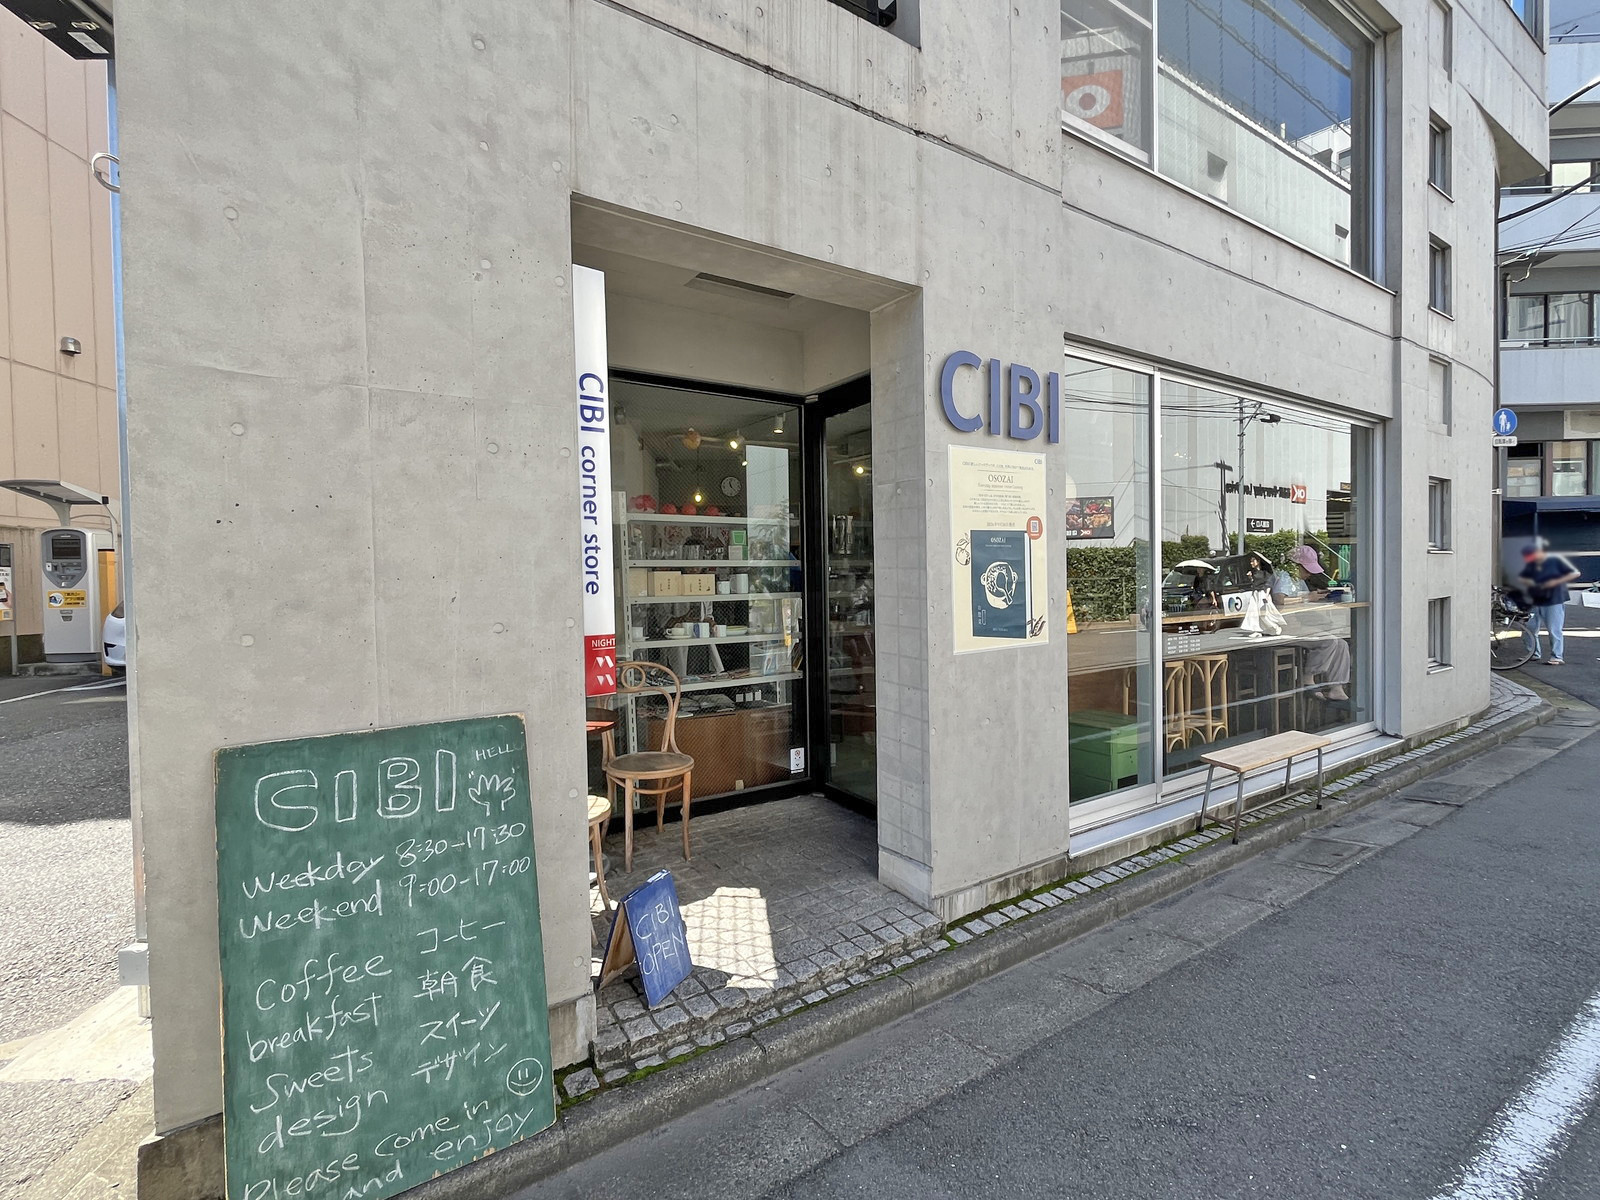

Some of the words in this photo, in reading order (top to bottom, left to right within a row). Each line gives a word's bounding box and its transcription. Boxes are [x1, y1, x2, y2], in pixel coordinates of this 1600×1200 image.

[578, 372, 606, 434] CIBI
[940, 350, 1060, 444] CIBI
[581, 445, 598, 526] corner
[987, 474, 1015, 484] OSOZAI
[584, 533, 602, 595] store
[591, 638, 616, 648] NIGHT
[254, 749, 457, 832] CIBI
[416, 918, 506, 954] コーヒー
[635, 895, 676, 940] CIBI
[413, 955, 498, 1000] 朝食
[642, 925, 685, 975] OPEN
[246, 992, 383, 1063] breakfast
[419, 1001, 502, 1046] スイーツ
[411, 1041, 508, 1084] デザイン
[257, 1089, 389, 1154] design
[374, 1114, 460, 1157] come
[464, 1099, 490, 1121] in
[343, 1158, 404, 1200] and
[430, 1107, 535, 1161] enjoy
